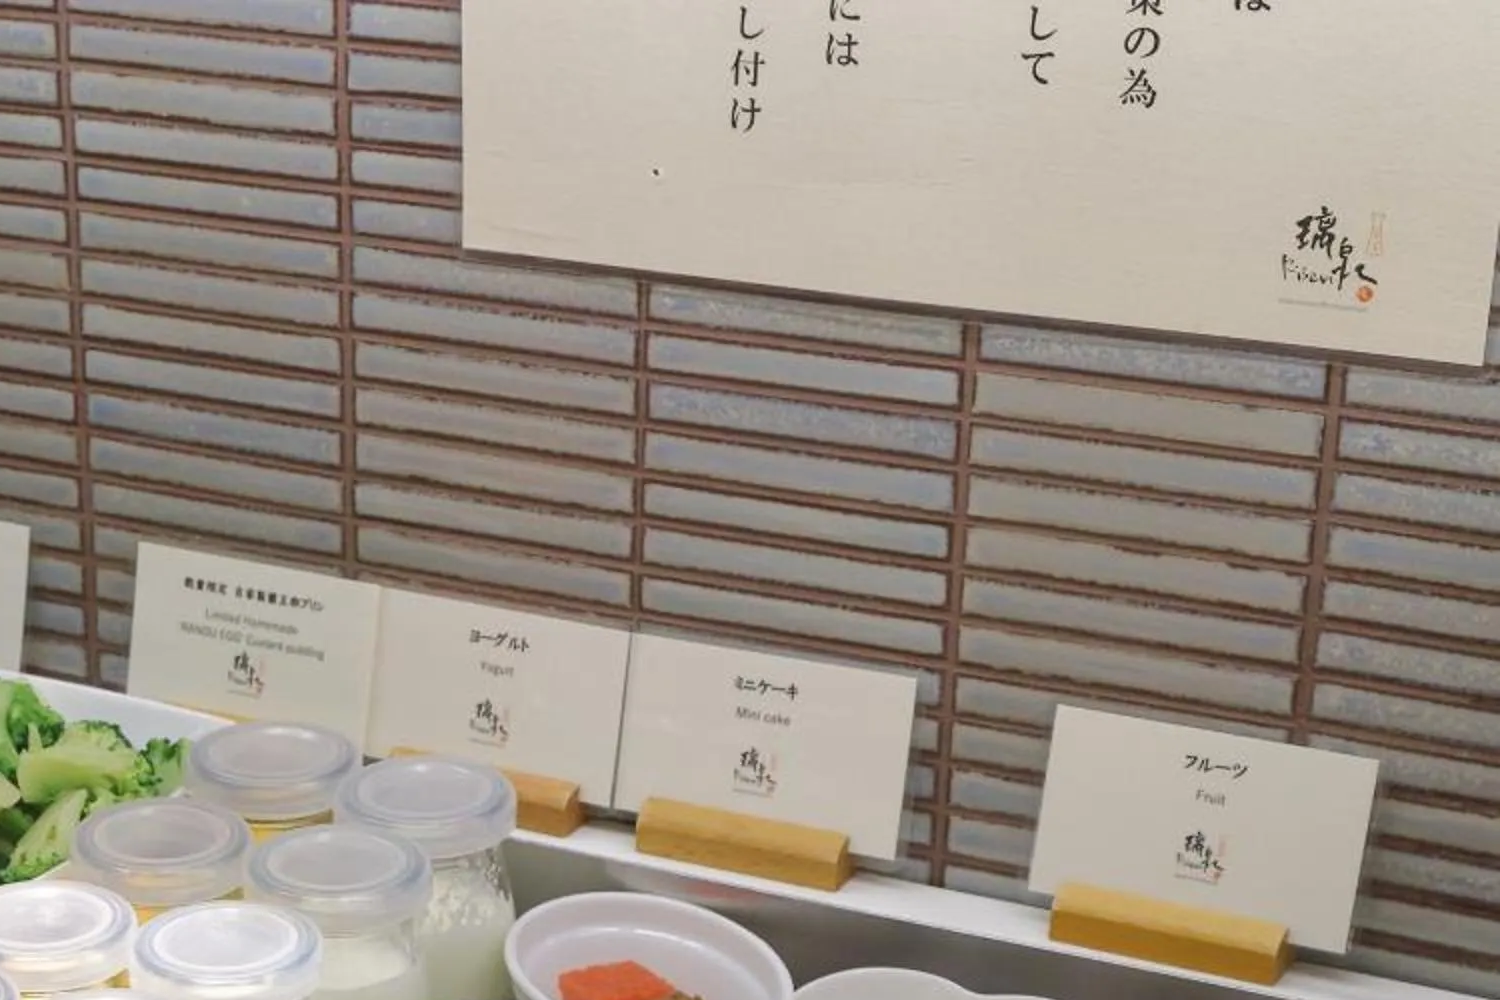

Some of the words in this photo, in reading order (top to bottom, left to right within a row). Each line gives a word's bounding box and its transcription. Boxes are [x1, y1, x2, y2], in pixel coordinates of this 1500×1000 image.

[1020, 6, 1058, 85] して
[730, 6, 766, 133] し付け
[470, 628, 530, 652] ヨーグルト
[734, 675, 799, 701] ミニケーキ
[1185, 754, 1249, 780] フルーツ
